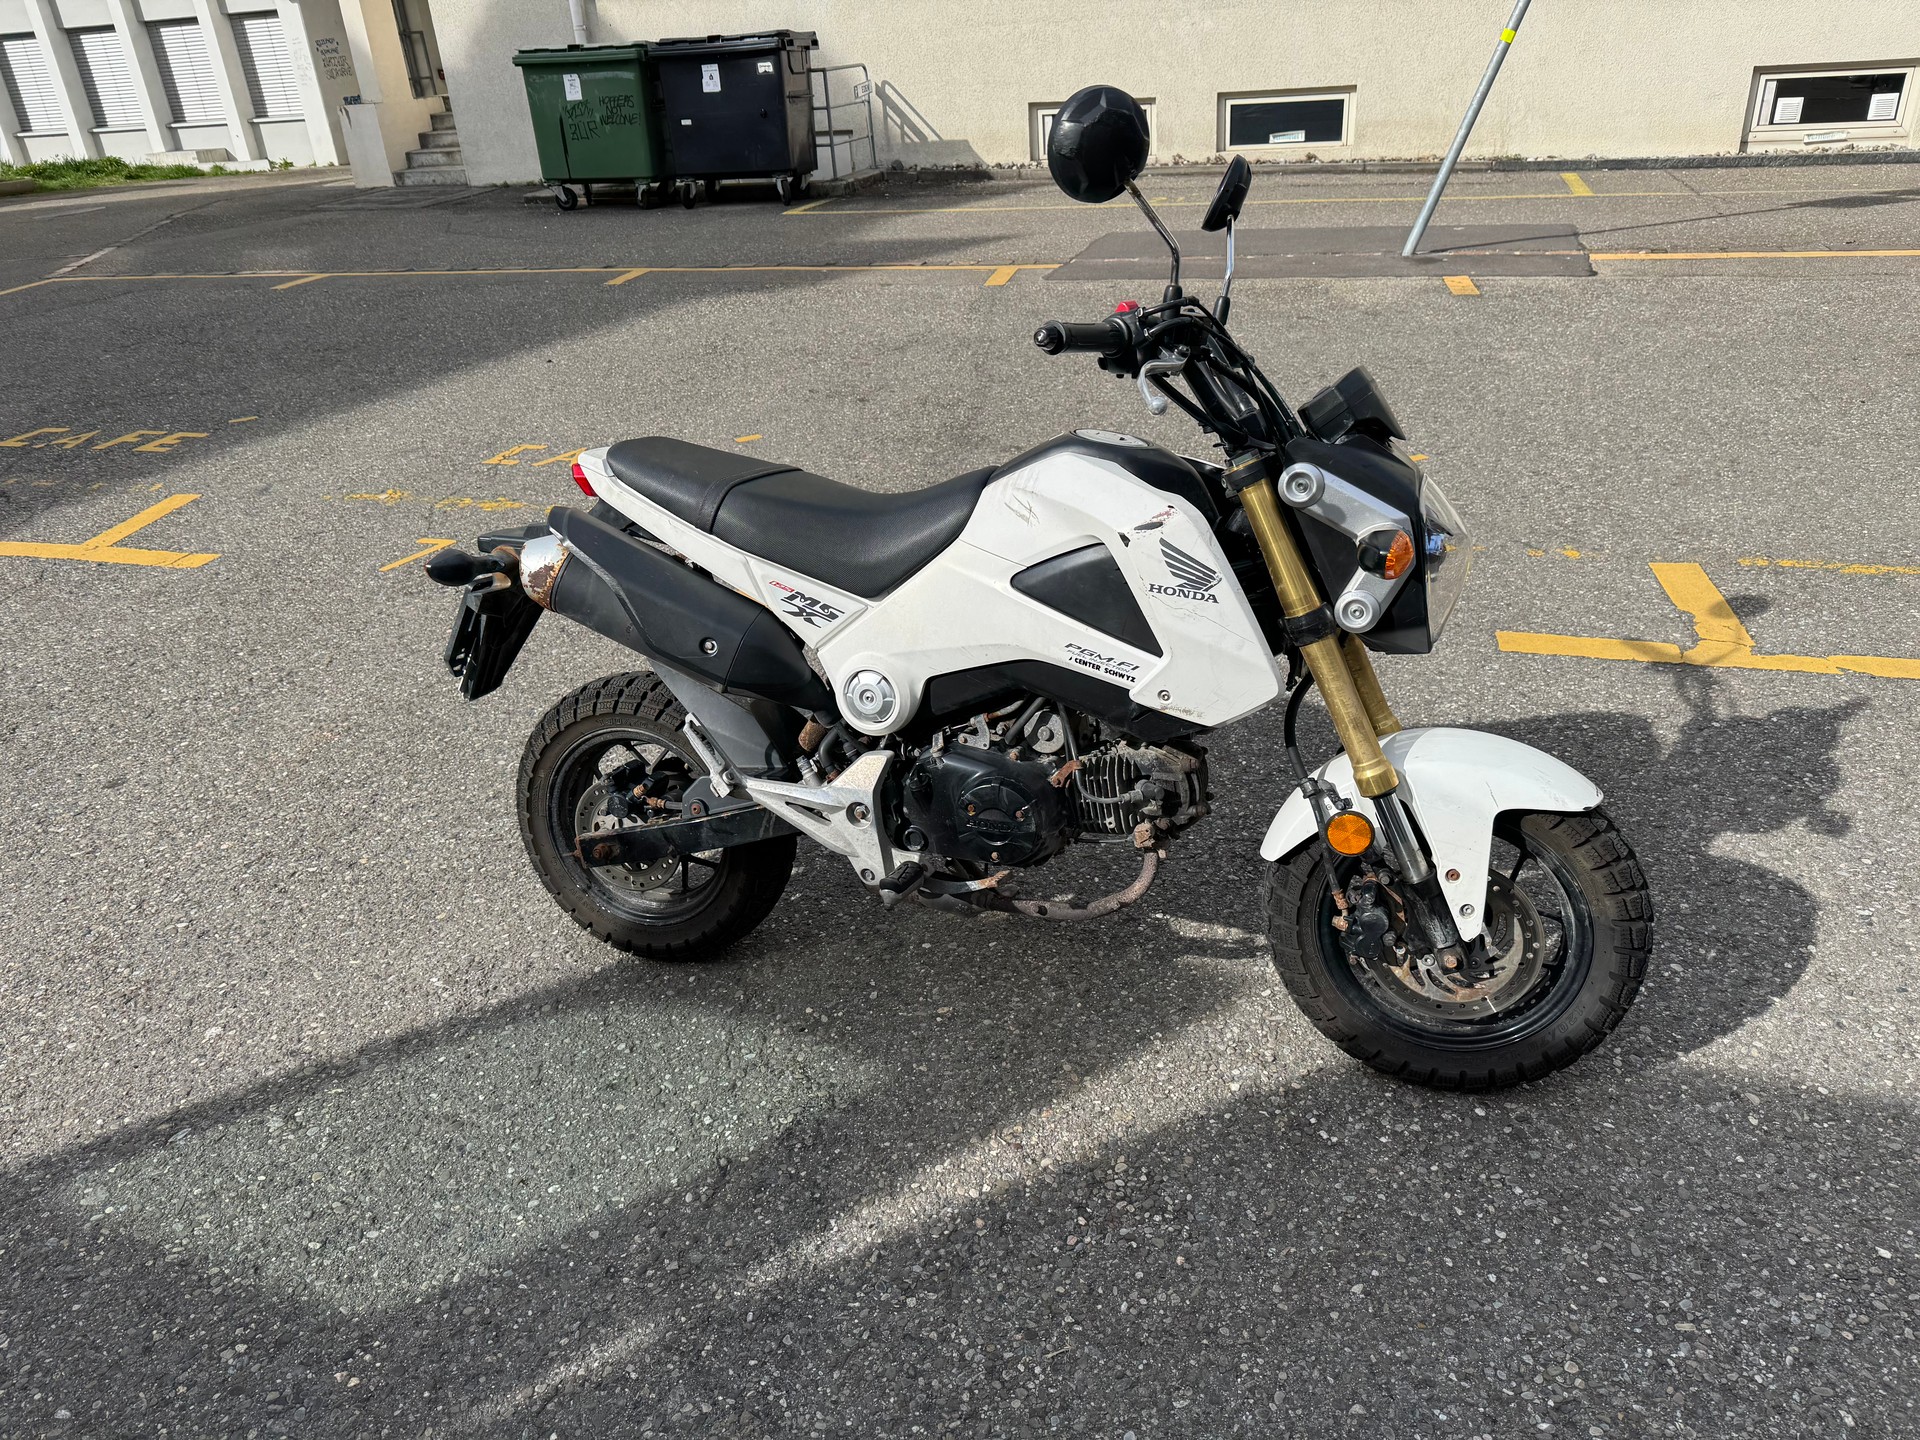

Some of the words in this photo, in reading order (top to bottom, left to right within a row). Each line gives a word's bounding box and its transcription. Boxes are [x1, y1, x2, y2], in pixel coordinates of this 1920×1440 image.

[605, 105, 622, 115] NOT
[481, 443, 588, 466] CA
[1148, 583, 1220, 604] HONDA
[1074, 657, 1101, 672] CENTER
[1103, 667, 1137, 683] SCHWYZ
